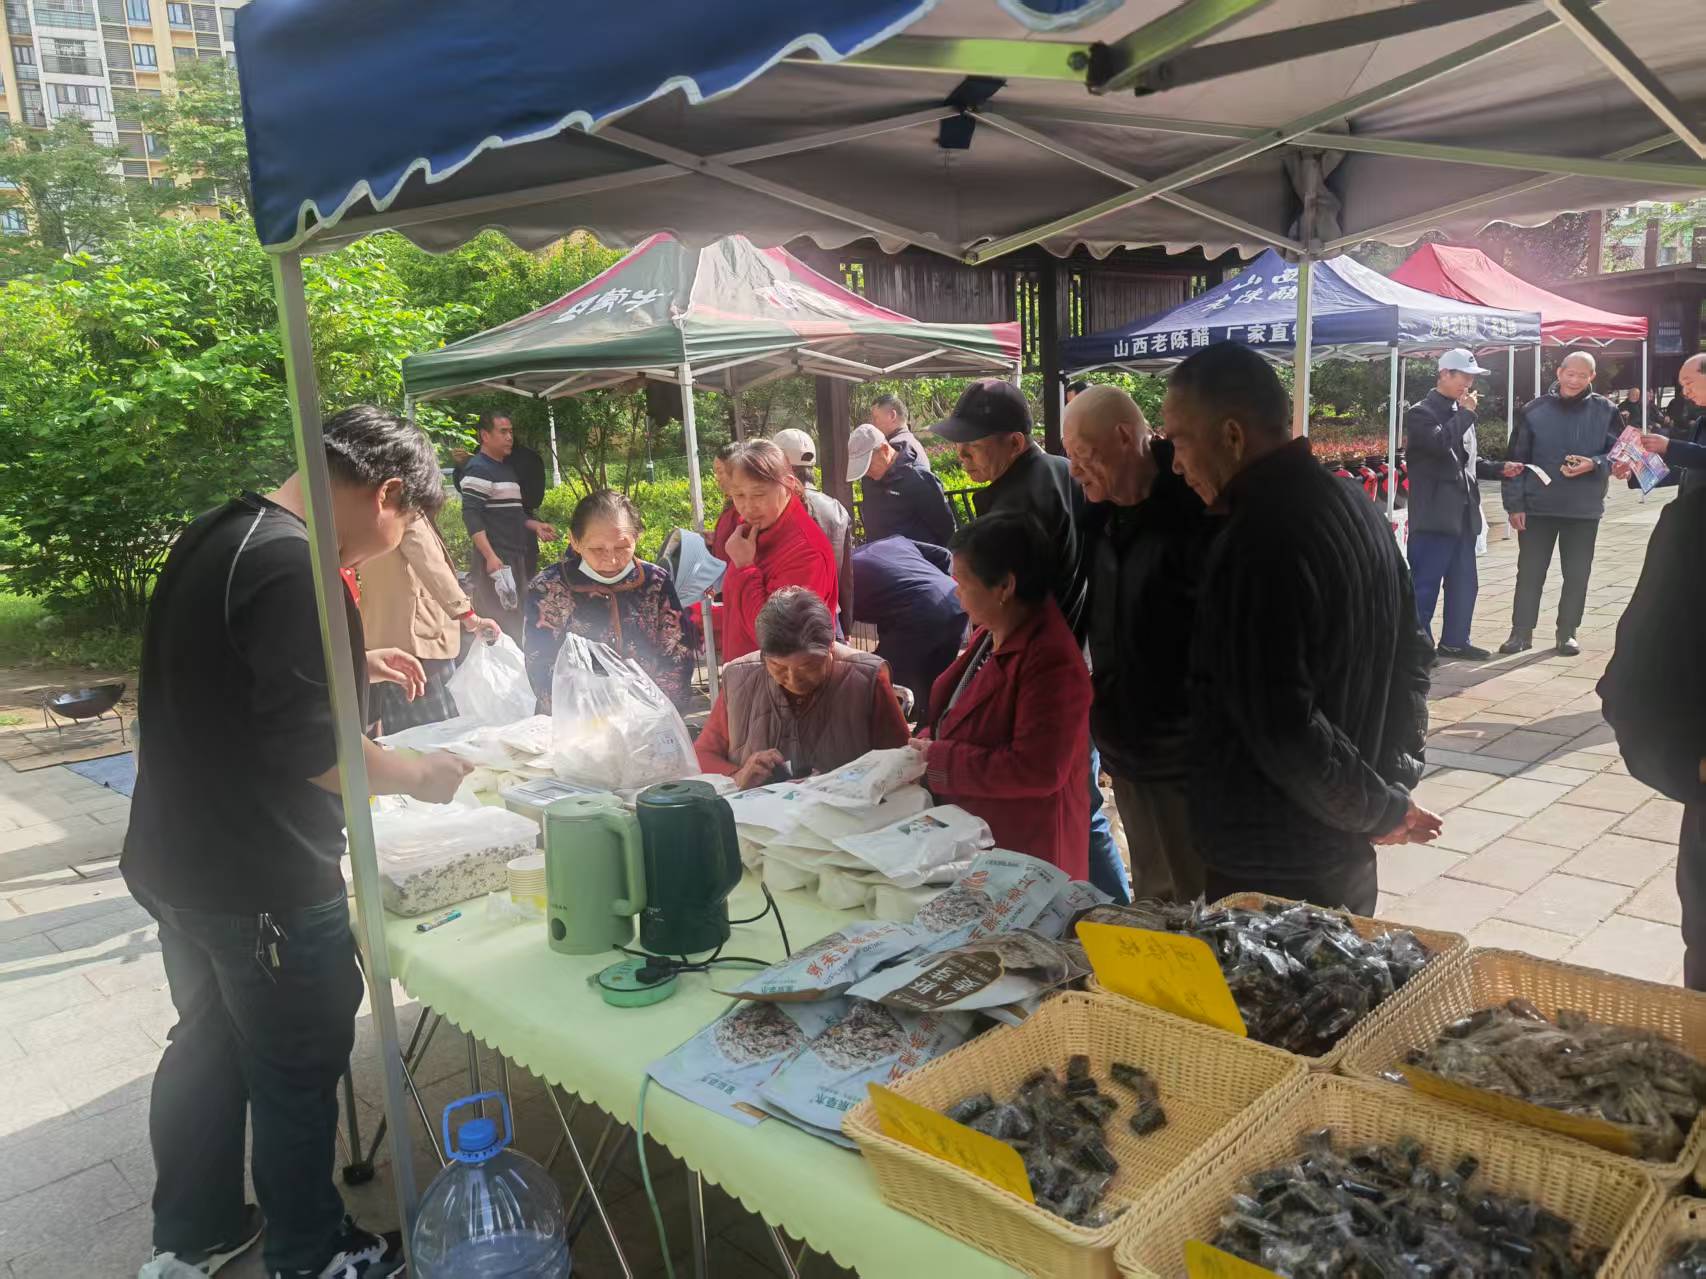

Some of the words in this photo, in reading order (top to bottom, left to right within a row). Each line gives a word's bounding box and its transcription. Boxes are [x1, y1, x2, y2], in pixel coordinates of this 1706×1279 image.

[1113, 326, 1210, 358] 山西老陈醋
[1226, 321, 1313, 344] 厂家直
